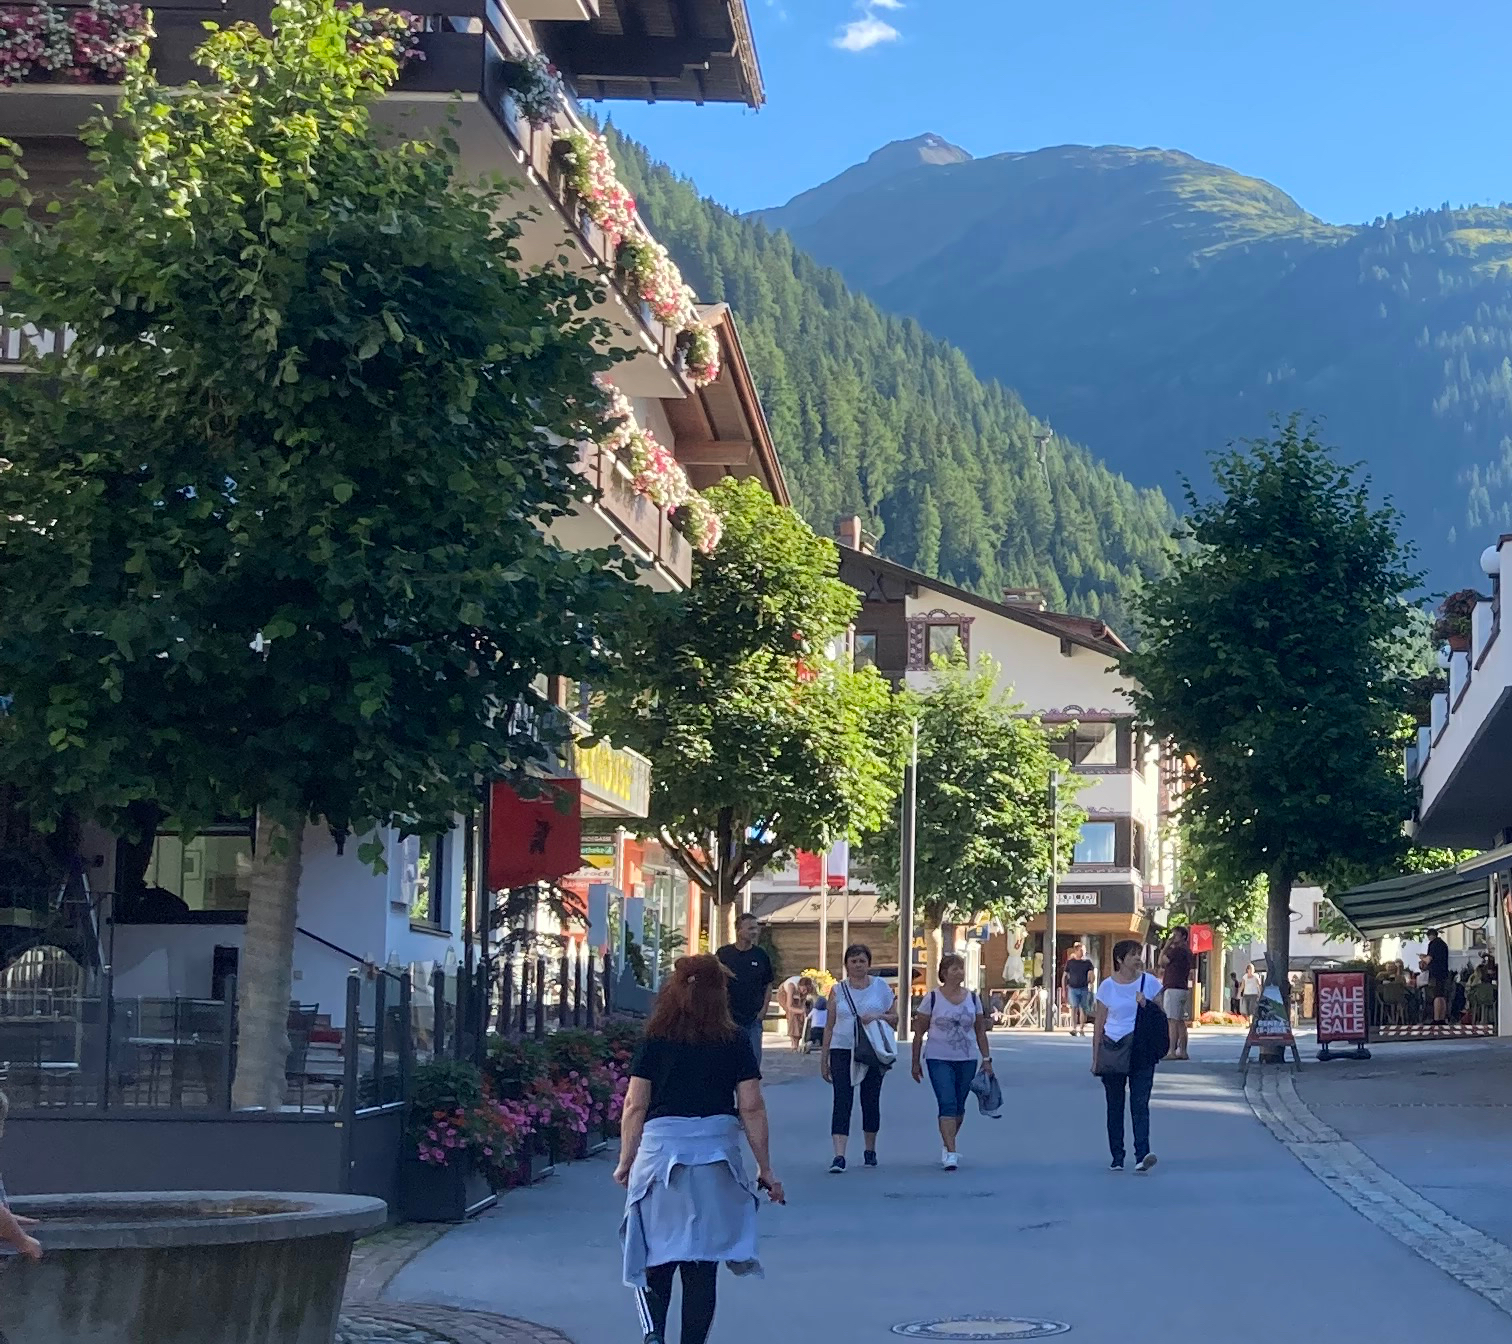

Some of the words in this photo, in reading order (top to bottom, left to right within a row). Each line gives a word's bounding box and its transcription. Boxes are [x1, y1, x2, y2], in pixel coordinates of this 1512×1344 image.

[1320, 986, 1364, 1003] SALE
[1320, 1002, 1364, 1018] SALE
[1320, 1017, 1364, 1034] SALE
